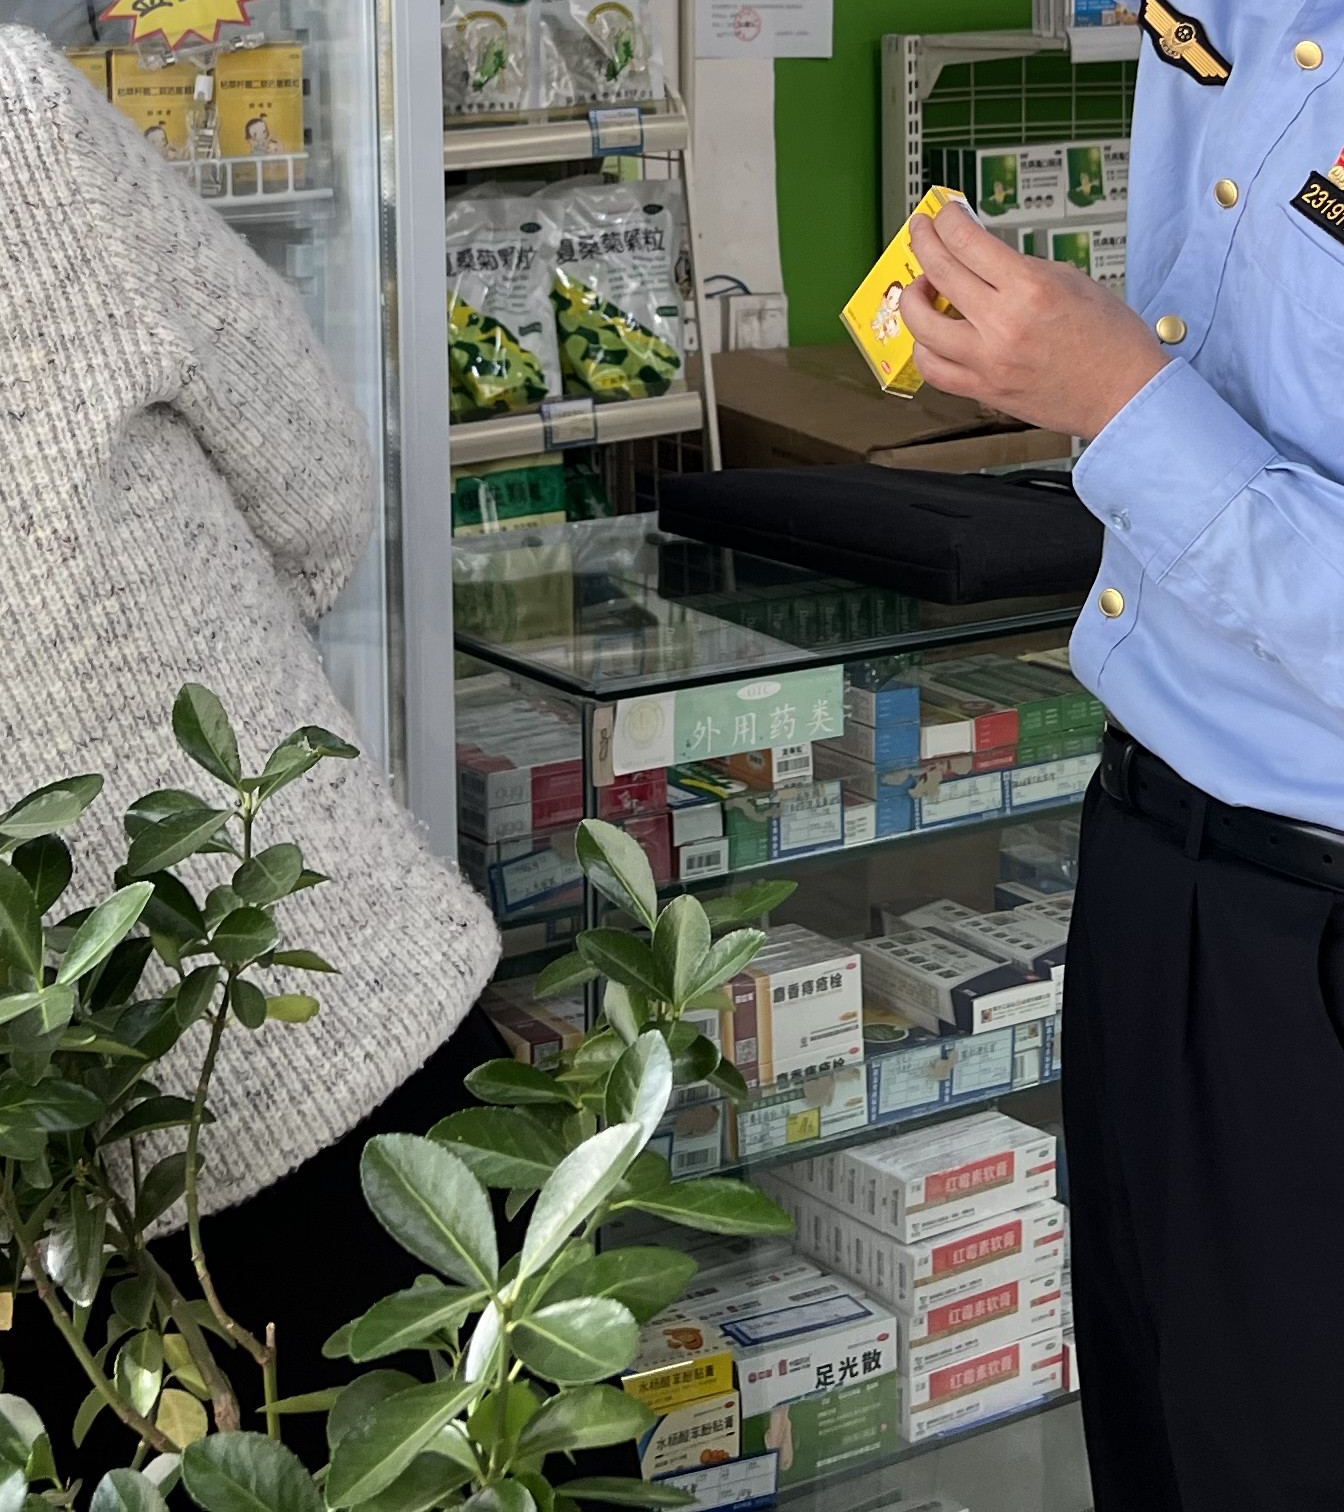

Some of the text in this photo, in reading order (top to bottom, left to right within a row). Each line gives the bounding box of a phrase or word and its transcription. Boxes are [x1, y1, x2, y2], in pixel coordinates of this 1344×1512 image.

[690, 699, 835, 754] 外用药类
[952, 1229, 1016, 1266] 红霉素软膏
[948, 1291, 1012, 1326] 红霉素软膏
[814, 1348, 883, 1390] 足光散
[949, 1354, 1013, 1389] 红霉素软膏
